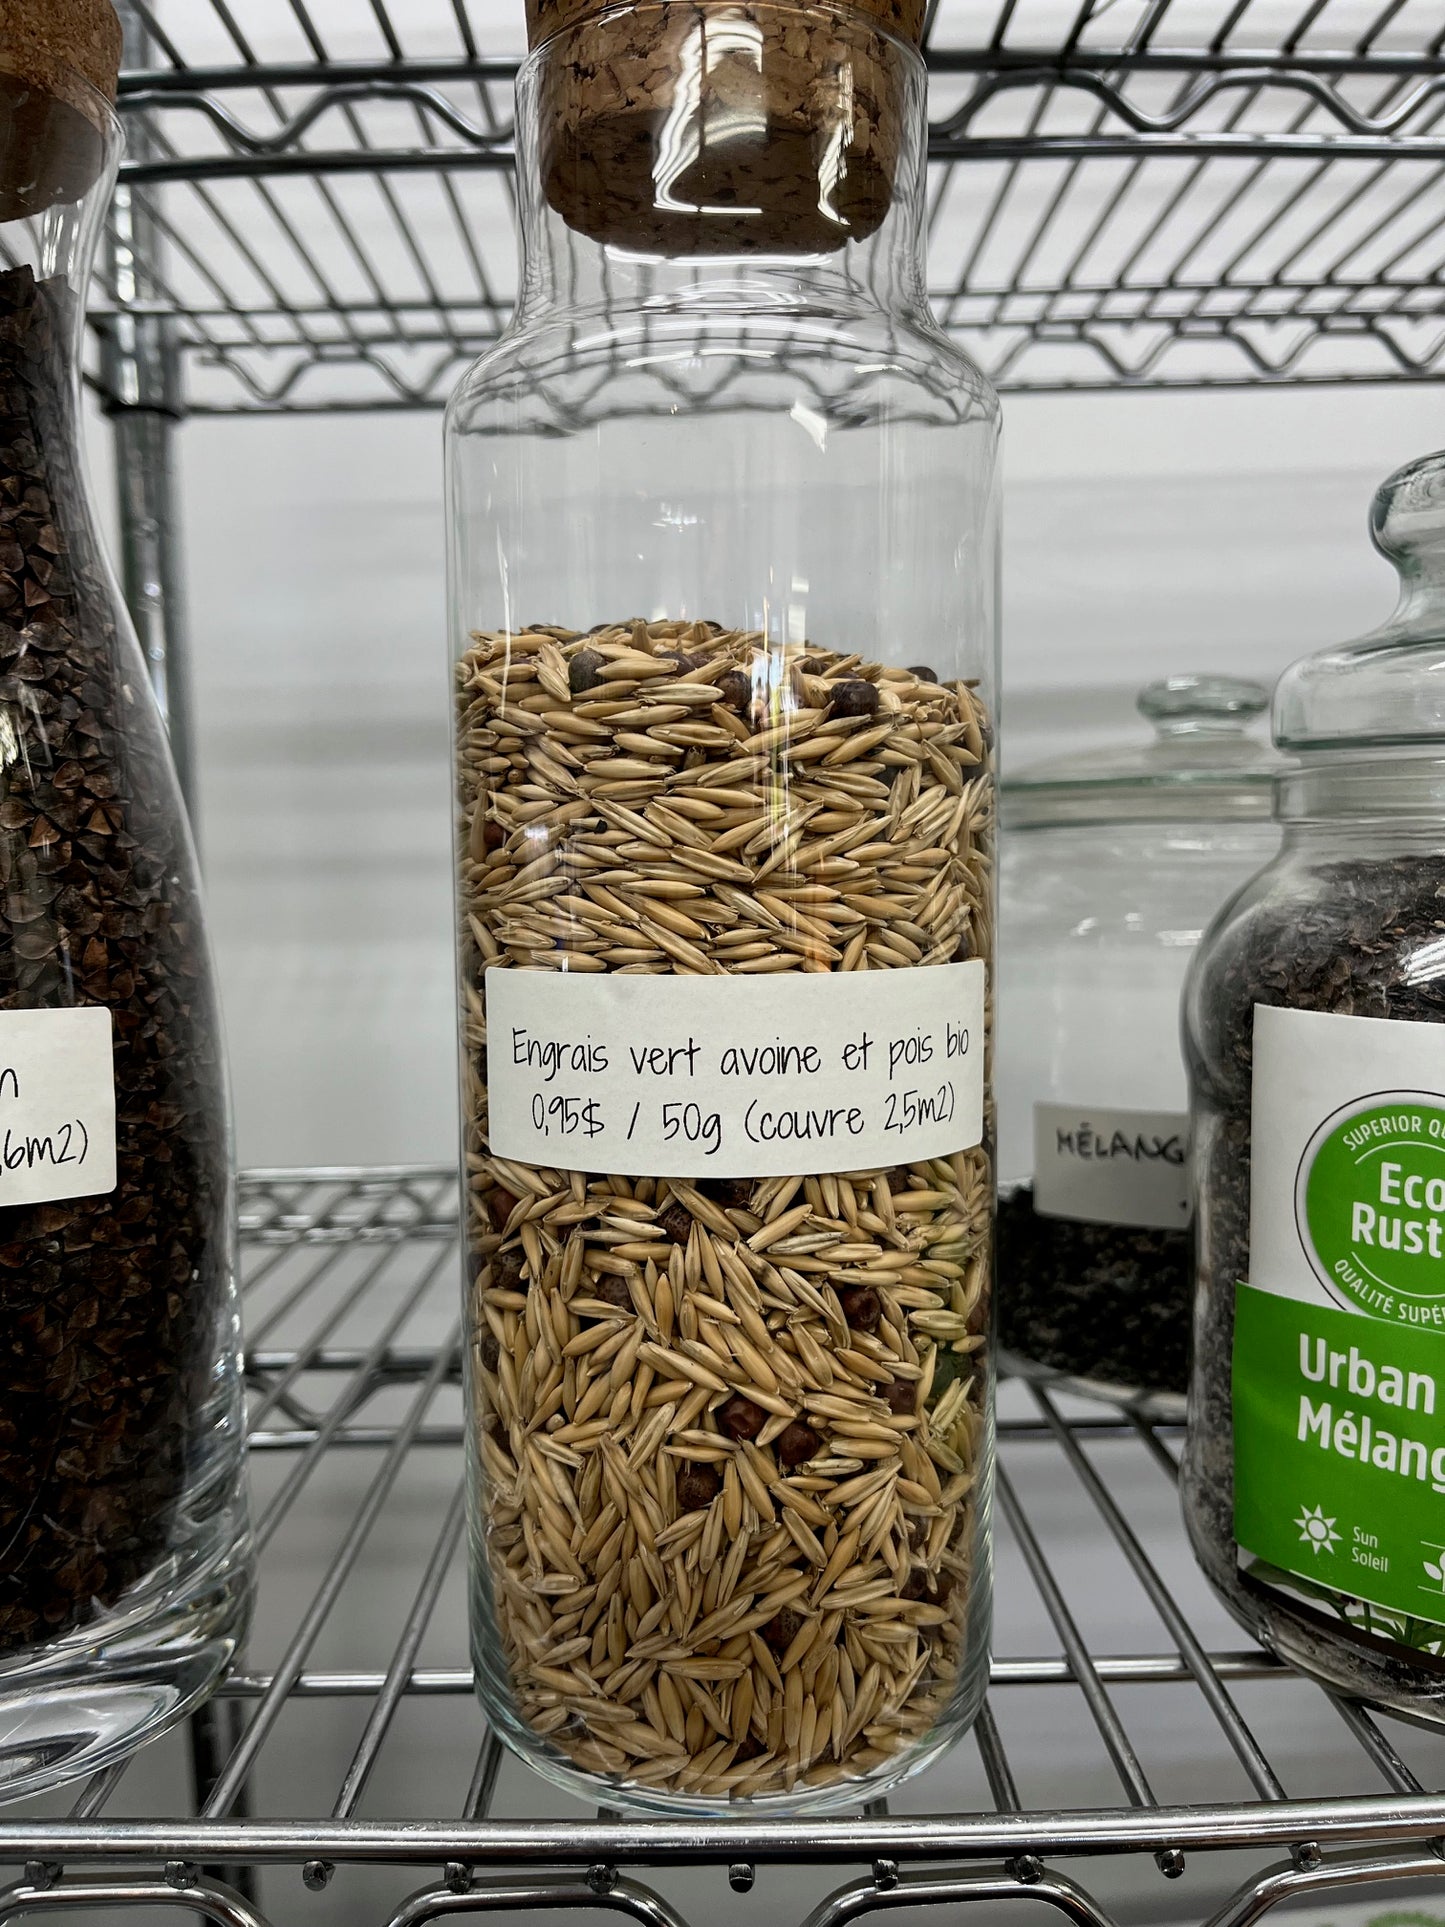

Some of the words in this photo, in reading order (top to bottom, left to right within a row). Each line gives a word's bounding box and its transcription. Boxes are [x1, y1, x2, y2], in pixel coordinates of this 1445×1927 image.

[513, 1028, 608, 1081] Engrais
[630, 1037, 701, 1076] vert
[720, 1036, 821, 1075] avoine
[842, 1032, 873, 1070] et
[890, 1026, 933, 1080] pois
[946, 1021, 969, 1058] bio
[532, 1093, 605, 1139] 0,95$
[626, 1102, 640, 1139] /
[662, 1102, 722, 1154] 50g
[745, 1099, 865, 1143] (couvre
[885, 1081, 955, 1135] 2,5m2)
[1342, 1115, 1421, 1151] SUPERIOR
[1380, 1161, 1445, 1212] Eco
[1352, 1202, 1443, 1258] Rust
[1334, 1259, 1394, 1314] QUALITÉ
[1397, 1303, 1445, 1325] SUPÉ
[1300, 1333, 1435, 1415] Urban
[1298, 1395, 1445, 1494] Mélang
[1352, 1547, 1388, 1573] Soleil
[1353, 1526, 1378, 1549] Sun
